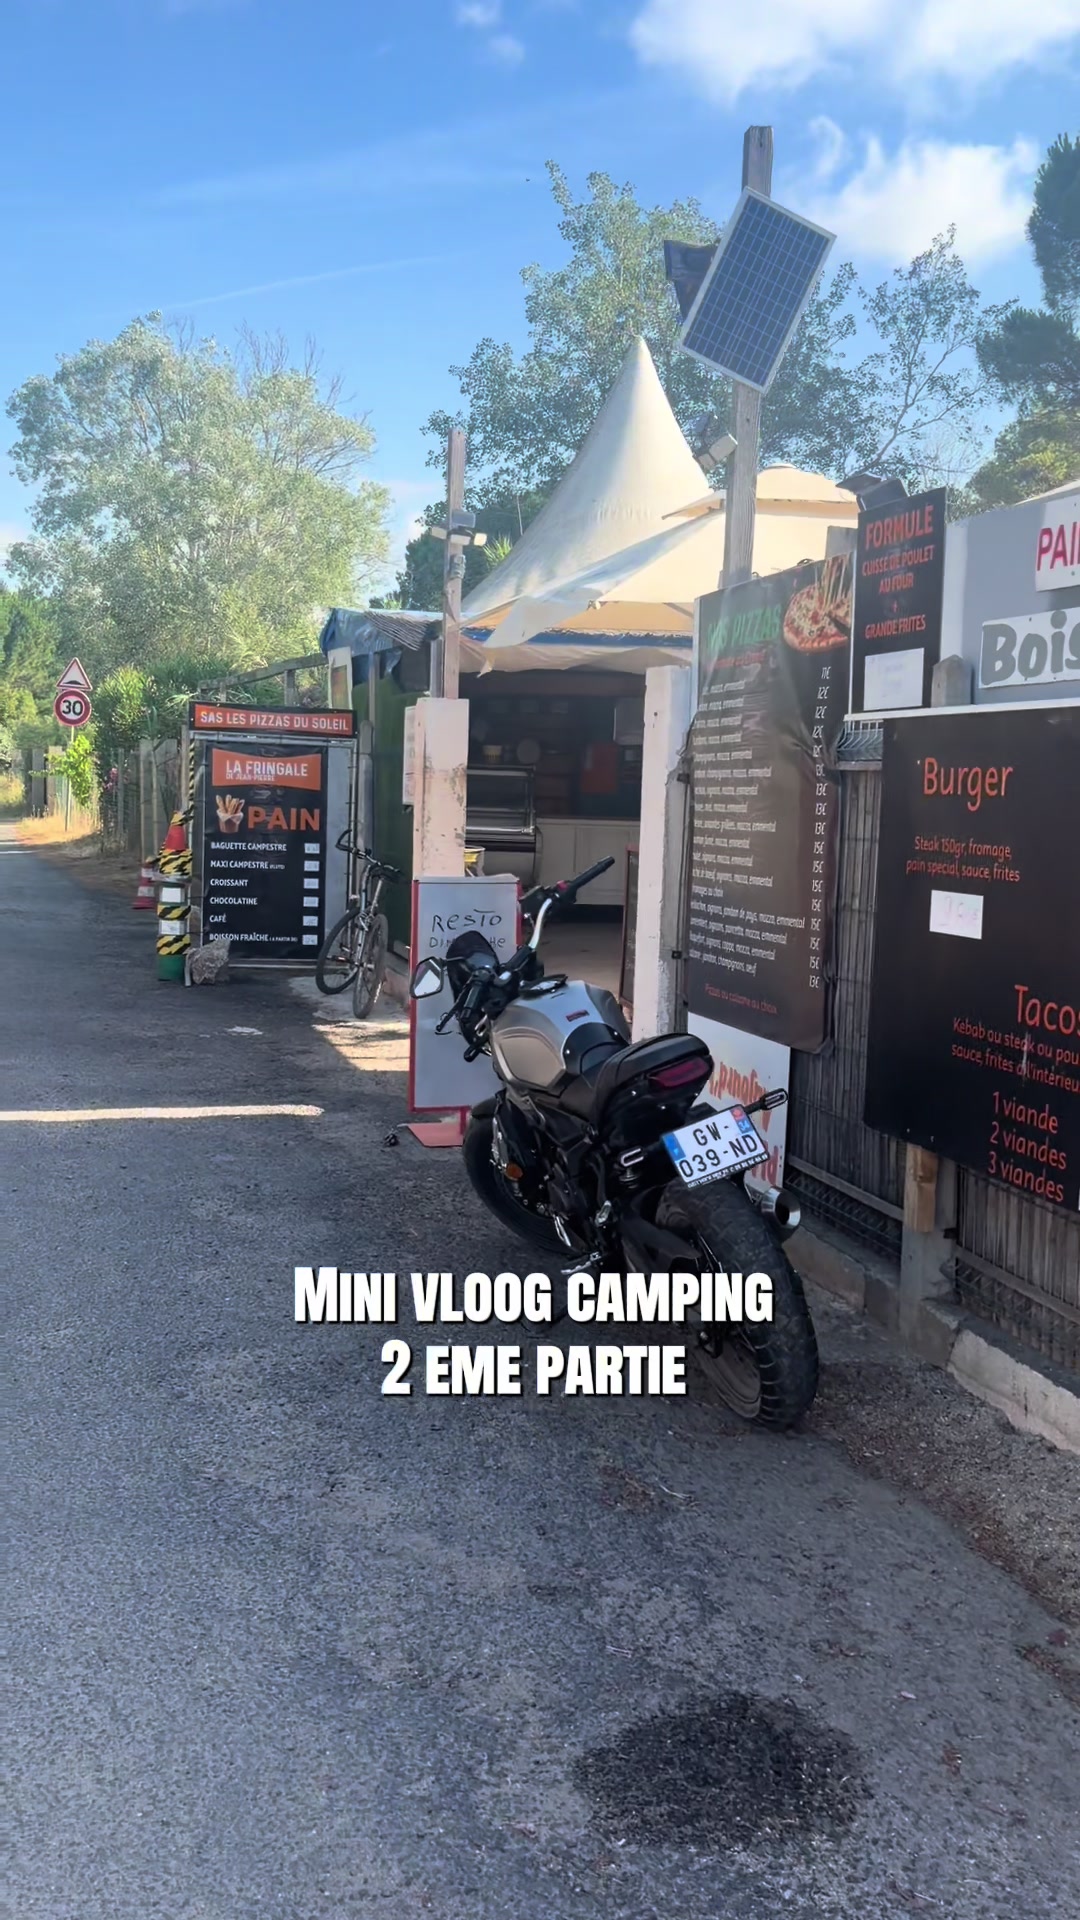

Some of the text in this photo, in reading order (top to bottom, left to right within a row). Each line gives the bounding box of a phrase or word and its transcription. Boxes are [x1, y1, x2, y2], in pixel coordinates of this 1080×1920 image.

[865, 504, 934, 551] FORMULE
[1036, 521, 1080, 571] PAI
[862, 556, 888, 576] CUISSE
[901, 545, 935, 567] POULET
[879, 572, 914, 593] AU FOUR
[731, 604, 782, 649] PIZZAS
[865, 614, 926, 639] GRANDE FRITES
[817, 686, 830, 699] 12€
[62, 699, 84, 717] 30
[815, 706, 827, 719] 12€
[200, 710, 349, 731] SAS LES PIZZAS DU SOLEIL
[812, 725, 823, 738] 12€
[226, 760, 309, 777] LA FRINGALE
[816, 783, 828, 796] 13€
[924, 757, 1013, 811] Burger
[815, 803, 827, 816] 13€
[247, 806, 320, 831] PAIN
[815, 822, 826, 835] 13€
[210, 841, 287, 852] BAGUETTE CAMPESTRE
[813, 841, 825, 854] 15€
[914, 835, 1012, 862] Steak 150gr, fromage,
[210, 860, 229, 868] MAXI
[229, 860, 269, 870] CAMPESTRE
[812, 860, 824, 873] 15€
[906, 860, 926, 875] pain
[961, 865, 991, 881] sauce,
[993, 863, 1020, 882] frites
[209, 878, 249, 887] CROISSANT
[812, 880, 823, 893] 15€
[209, 896, 258, 906] CHOCOLATINE
[811, 899, 822, 912] 15€
[209, 913, 227, 923] CAFÉ
[810, 918, 821, 931] 15€
[209, 933, 240, 941] BOISSON
[240, 932, 269, 942] FRAÎCHE
[809, 937, 821, 950] 15€
[809, 956, 820, 969] 15€
[809, 975, 820, 988] 13€
[953, 1017, 986, 1039] Kebab
[987, 1030, 1002, 1044] ou
[1004, 1031, 1034, 1053] steak
[1037, 1043, 1053, 1058] ou
[951, 1044, 982, 1067] sauce,
[985, 1047, 1014, 1073] frites
[993, 1091, 1058, 1134] 1 viande
[990, 1121, 1067, 1170] 2 viandes
[678, 1134, 758, 1178] 039-ND
[988, 1151, 1064, 1202] 3 viandes
